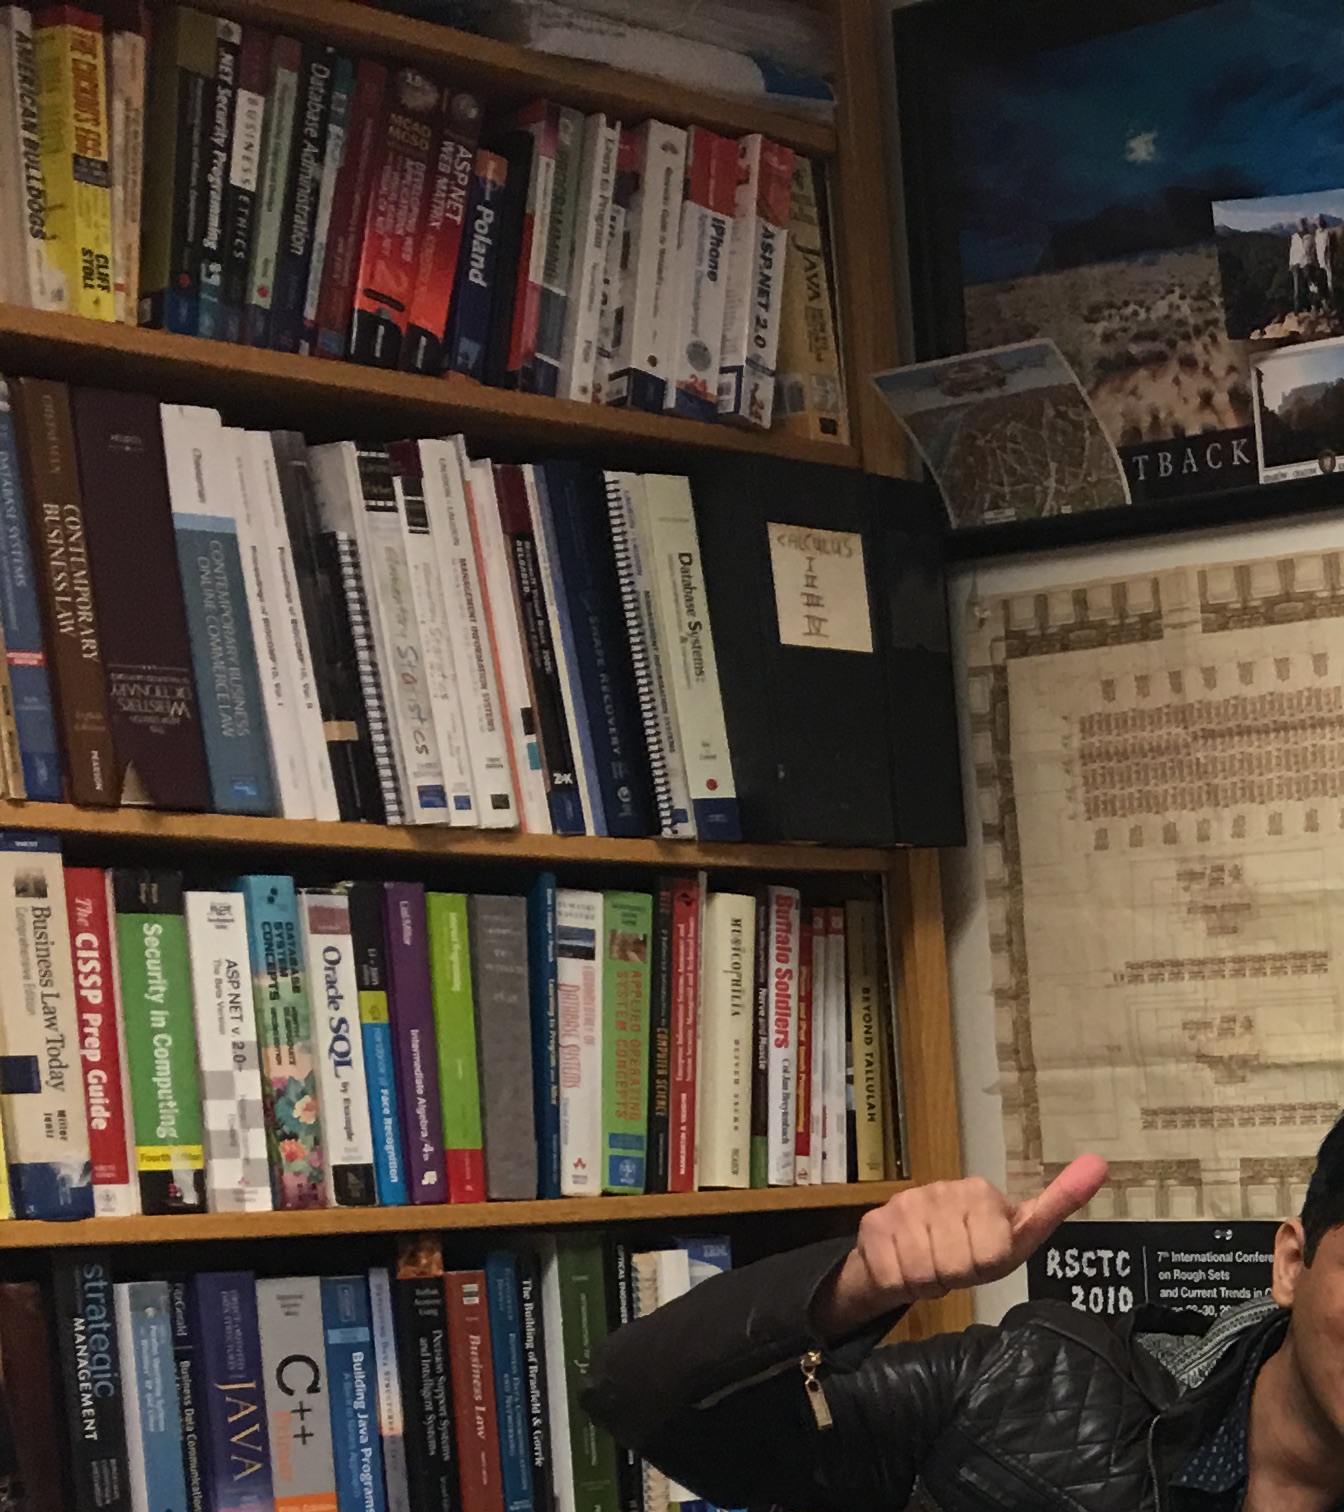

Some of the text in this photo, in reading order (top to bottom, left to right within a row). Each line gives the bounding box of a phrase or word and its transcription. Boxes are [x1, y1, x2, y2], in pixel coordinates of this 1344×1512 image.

[14, 31, 47, 240] AMERICAN BULLDOGS
[210, 85, 230, 147] Security
[289, 63, 330, 255] Database Administration
[231, 96, 261, 260] BUSINESS ETHICS
[94, 254, 109, 292] CLIFF
[467, 205, 495, 287] Poland
[753, 227, 774, 349] ASP.NET 2.0
[42, 503, 76, 639] BUSINESS LAW
[63, 504, 99, 664] CONTEMPORARY
[677, 552, 700, 617] Database
[776, 533, 854, 559] CALCULUS
[196, 556, 227, 700] ONLINE COMMERCE
[207, 540, 250, 737] CONTEMPORARY BUSINESS
[598, 673, 622, 755] RECOVERY
[260, 921, 280, 1001] CONCEPTS
[272, 921, 288, 977] SYSTEM
[283, 922, 302, 994] DATABASE
[773, 894, 793, 1049] Buffalo Soldiers
[30, 906, 68, 1091] Business Law Today
[74, 898, 110, 1130] The CISSP Prep Guide
[141, 923, 179, 1139] Security in Computing
[321, 946, 353, 1079] Oracle SQL
[409, 1029, 427, 1094] Intermediate
[615, 971, 629, 1119] SYSTEM CONCEPTS
[859, 987, 877, 1123] BEYOND TALLULAH
[382, 1118, 400, 1182] Recognition
[1046, 1247, 1131, 1279] RSCTC
[1071, 1284, 1133, 1315] 2010
[1158, 1268, 1230, 1282] on Rough Sets
[1160, 1286, 1251, 1299] and Current Trends
[1171, 1250, 1233, 1264] International
[1235, 1250, 1275, 1264] Confere
[80, 1263, 118, 1399] strategic
[520, 1279, 536, 1343] The Building
[72, 1317, 98, 1441] MANAGEMENT
[274, 1354, 321, 1446] C++
[348, 1351, 369, 1409] Building
[468, 1334, 487, 1440] Business Law
[212, 1379, 263, 1482] JAVA
[351, 1413, 371, 1445] Java
